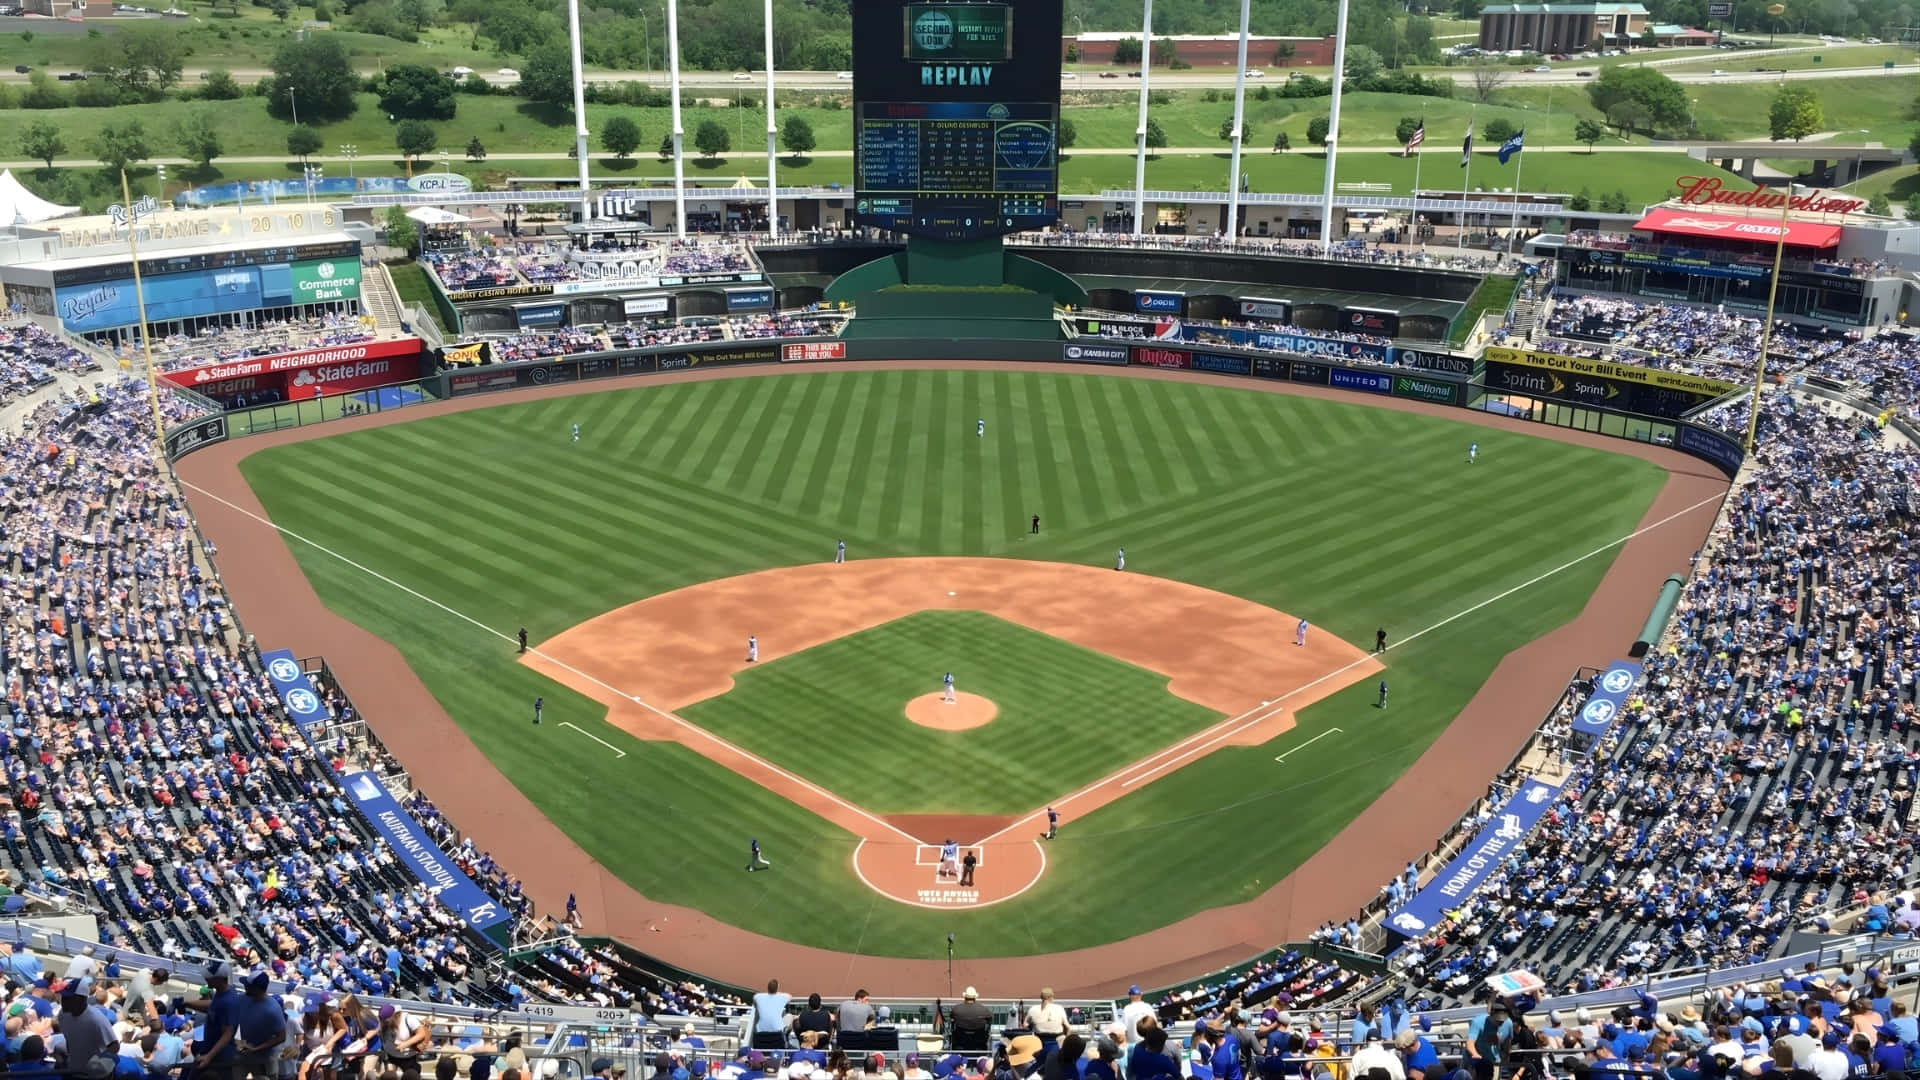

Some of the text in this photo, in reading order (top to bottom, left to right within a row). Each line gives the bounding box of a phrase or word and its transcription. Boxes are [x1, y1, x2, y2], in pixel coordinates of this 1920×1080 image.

[921, 66, 993, 86] REPLAY
[1676, 175, 1865, 214] Budweiser
[106, 195, 158, 225] Royals
[148, 218, 208, 241] FAME
[250, 216, 272, 233] 20
[288, 213, 304, 231] 10
[299, 277, 355, 291] Commerce
[316, 288, 343, 300] Bank
[478, 289, 505, 297] CASINO
[63, 285, 117, 320] Royals
[1259, 335, 1295, 352] PEPSI
[1297, 338, 1344, 356] PORCH
[270, 347, 367, 370] NEIGHBORHOOD
[445, 350, 481, 361] SONIC
[661, 357, 688, 369] Sprint
[1110, 351, 1126, 359] CITY
[1417, 352, 1469, 373] IVY FUNDS
[1526, 354, 1546, 365] The
[1548, 357, 1568, 369] Cut
[1569, 360, 1594, 373] Your
[1596, 364, 1613, 375] Bill
[1615, 368, 1648, 381] Event
[1334, 374, 1377, 386] UNITED
[1503, 370, 1546, 391] Sprint
[1575, 381, 1606, 396] Sprint
[1410, 381, 1450, 397] National
[378, 810, 460, 890] KAUFFMAN STADIUM
[1440, 837, 1507, 897] HOME OF THE
[917, 889, 979, 897] VOTE ROYALS
[534, 1007, 554, 1017] 419
[596, 1010, 616, 1020] 420
